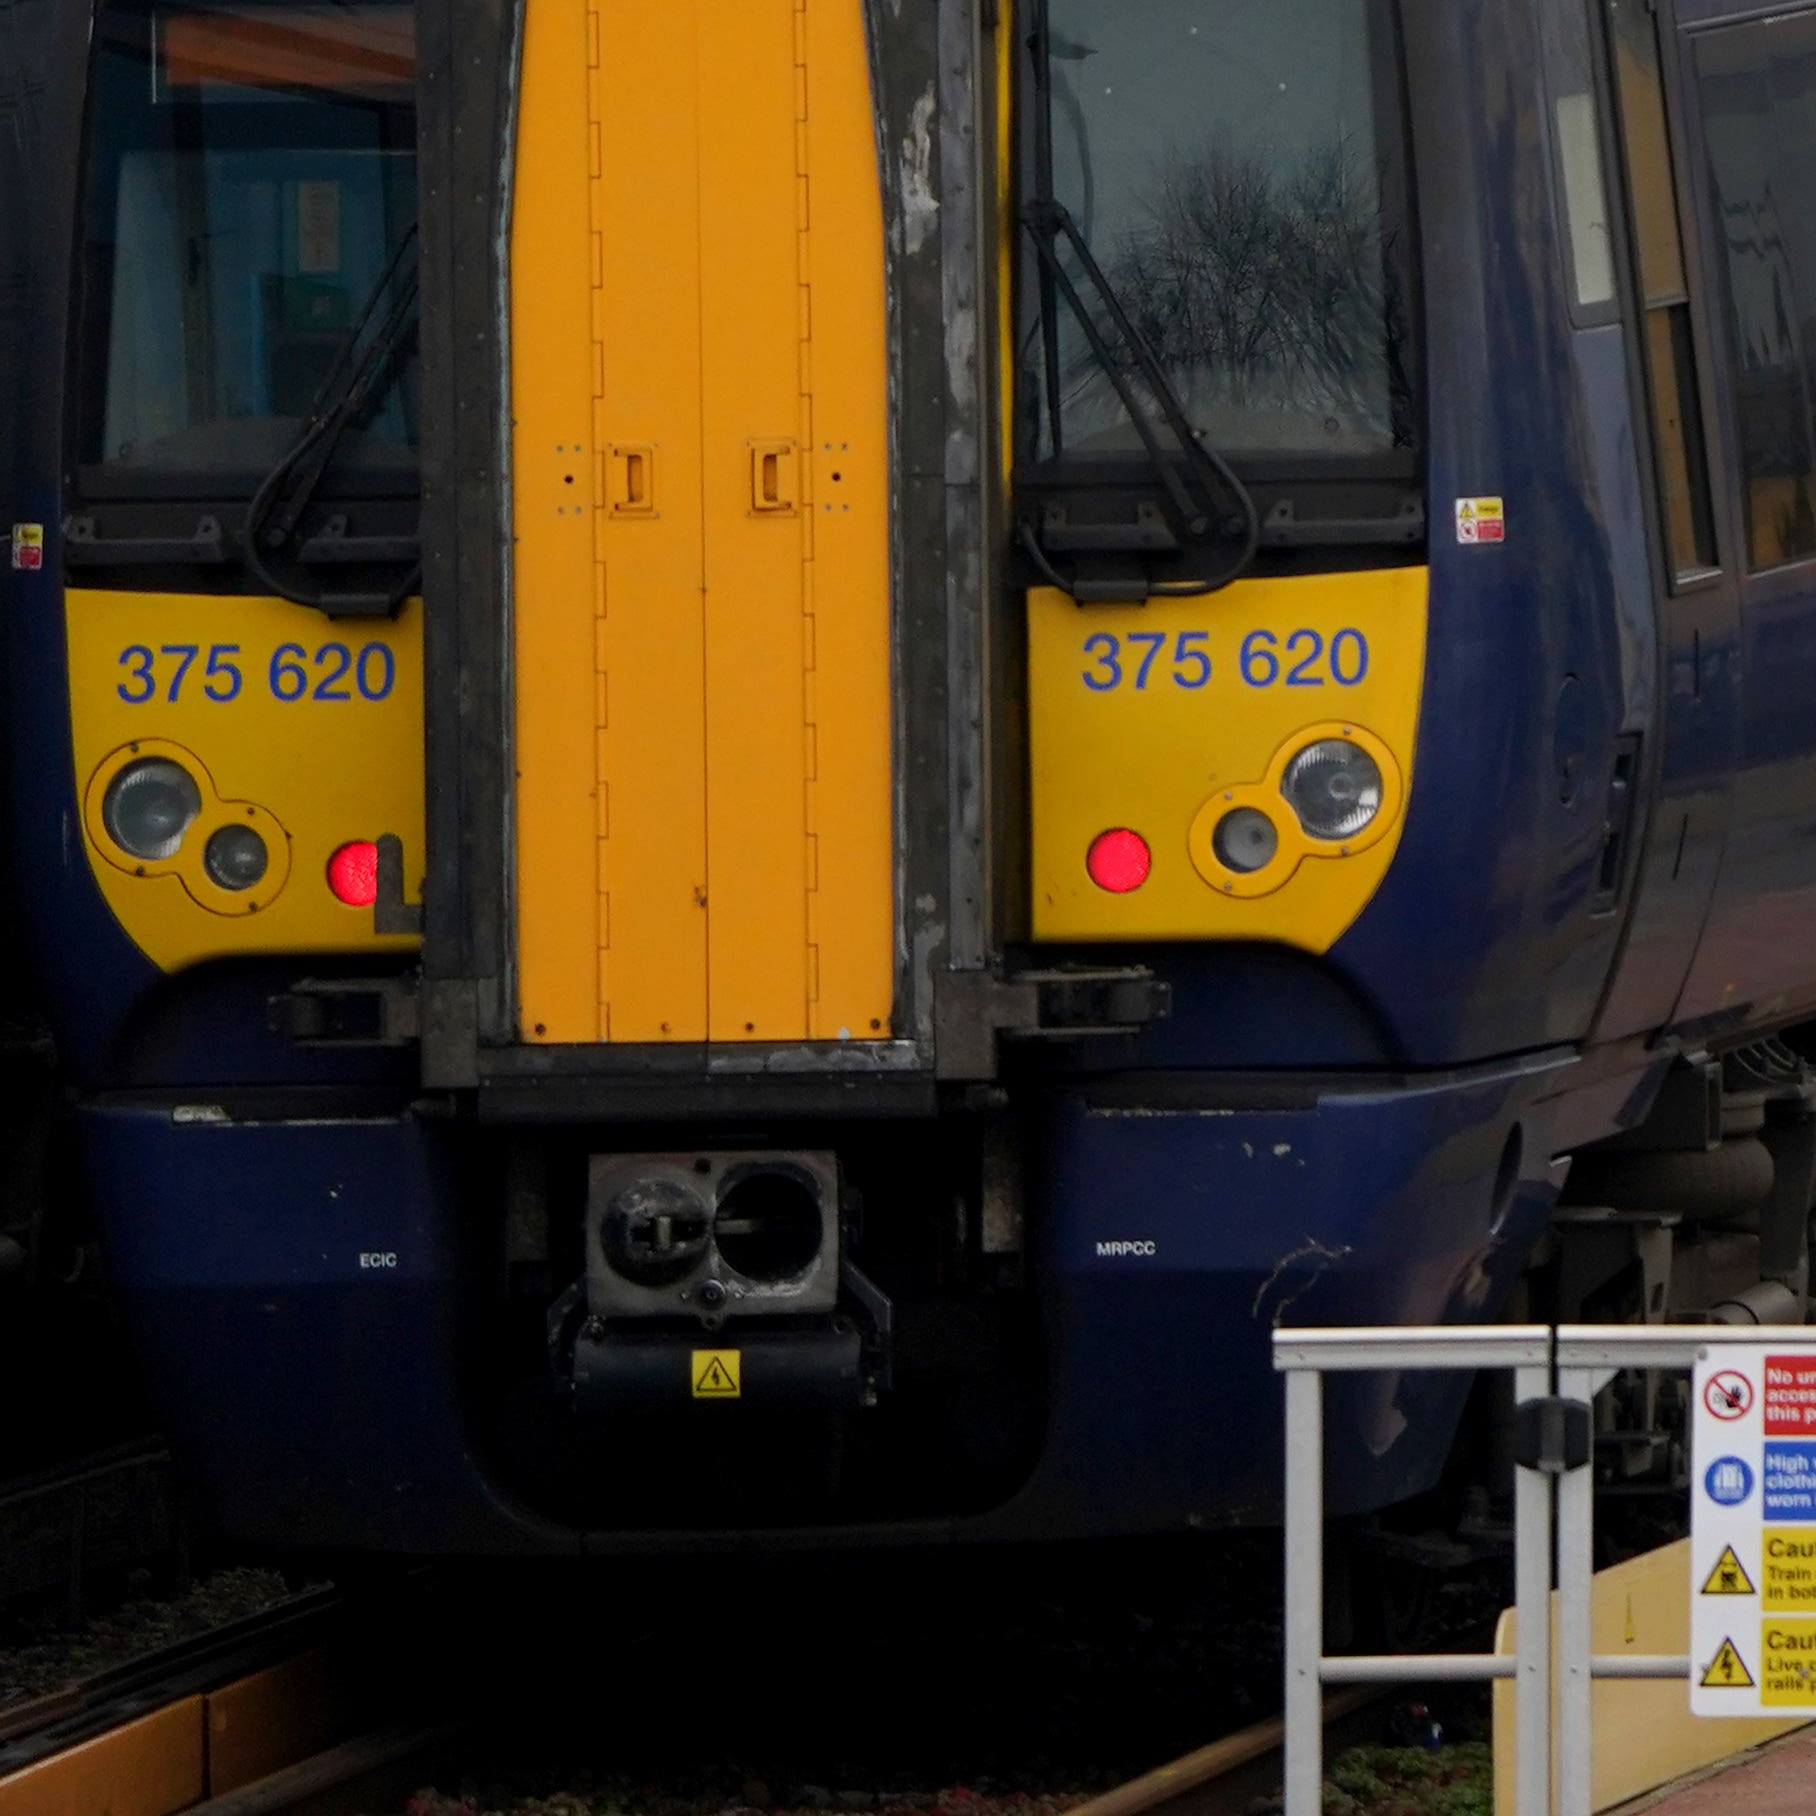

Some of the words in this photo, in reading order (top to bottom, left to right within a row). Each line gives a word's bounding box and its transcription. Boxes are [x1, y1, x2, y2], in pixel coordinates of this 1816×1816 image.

[1081, 631, 1212, 691] 375
[1239, 628, 1369, 688] 620
[117, 644, 243, 704] 375
[269, 641, 396, 702] 620
[1096, 1240, 1156, 1256] MRPCC
[359, 1252, 398, 1269] ECIC
[1766, 1368, 1793, 1384] No
[1766, 1405, 1800, 1422] this
[1766, 1453, 1809, 1474] High
[1766, 1493, 1812, 1508] worn
[1768, 1566, 1812, 1580] Train
[1768, 1585, 1784, 1600] in
[1767, 1658, 1803, 1672] Live
[1767, 1676, 1804, 1691] rails
